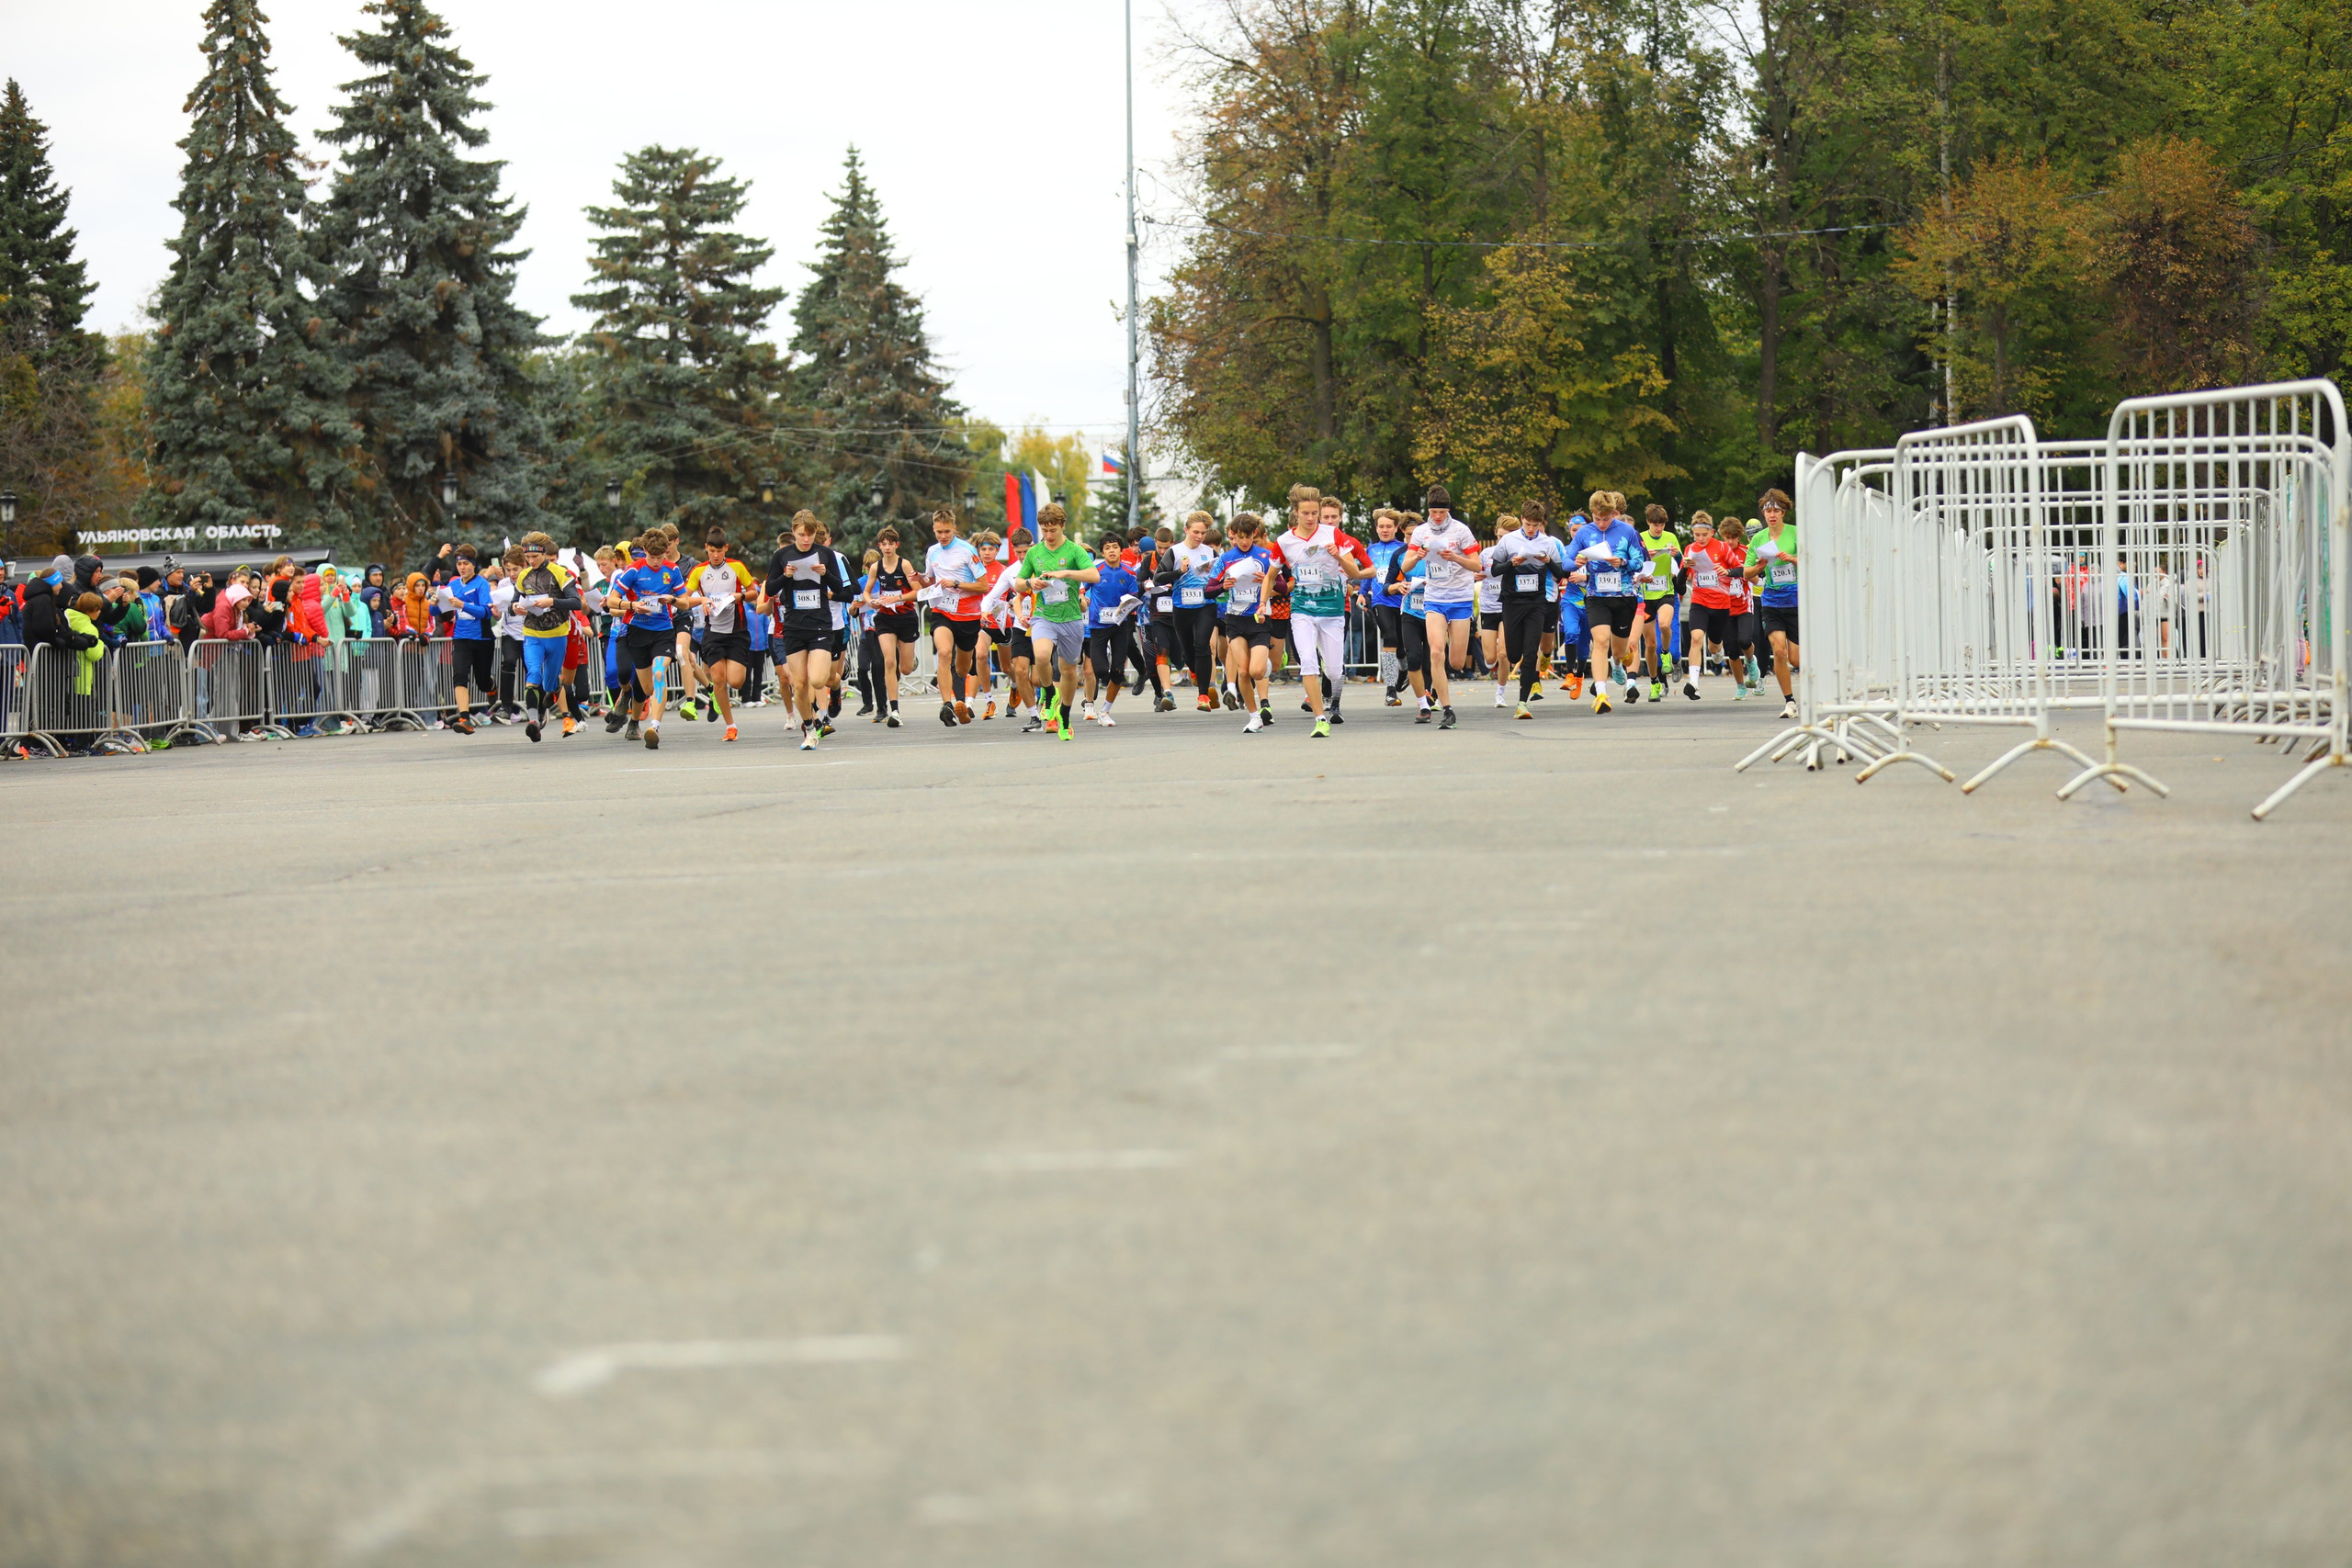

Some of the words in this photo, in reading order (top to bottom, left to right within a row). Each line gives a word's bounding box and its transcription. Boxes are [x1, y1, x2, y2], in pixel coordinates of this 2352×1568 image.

[77, 526, 195, 545] УЛЬЯНОВСКАЯ
[207, 525, 282, 539] ОБЛАСТЬ
[1298, 567, 1318, 576] 314.1
[1772, 569, 1792, 578] 320.1
[797, 593, 816, 602] 308.1
